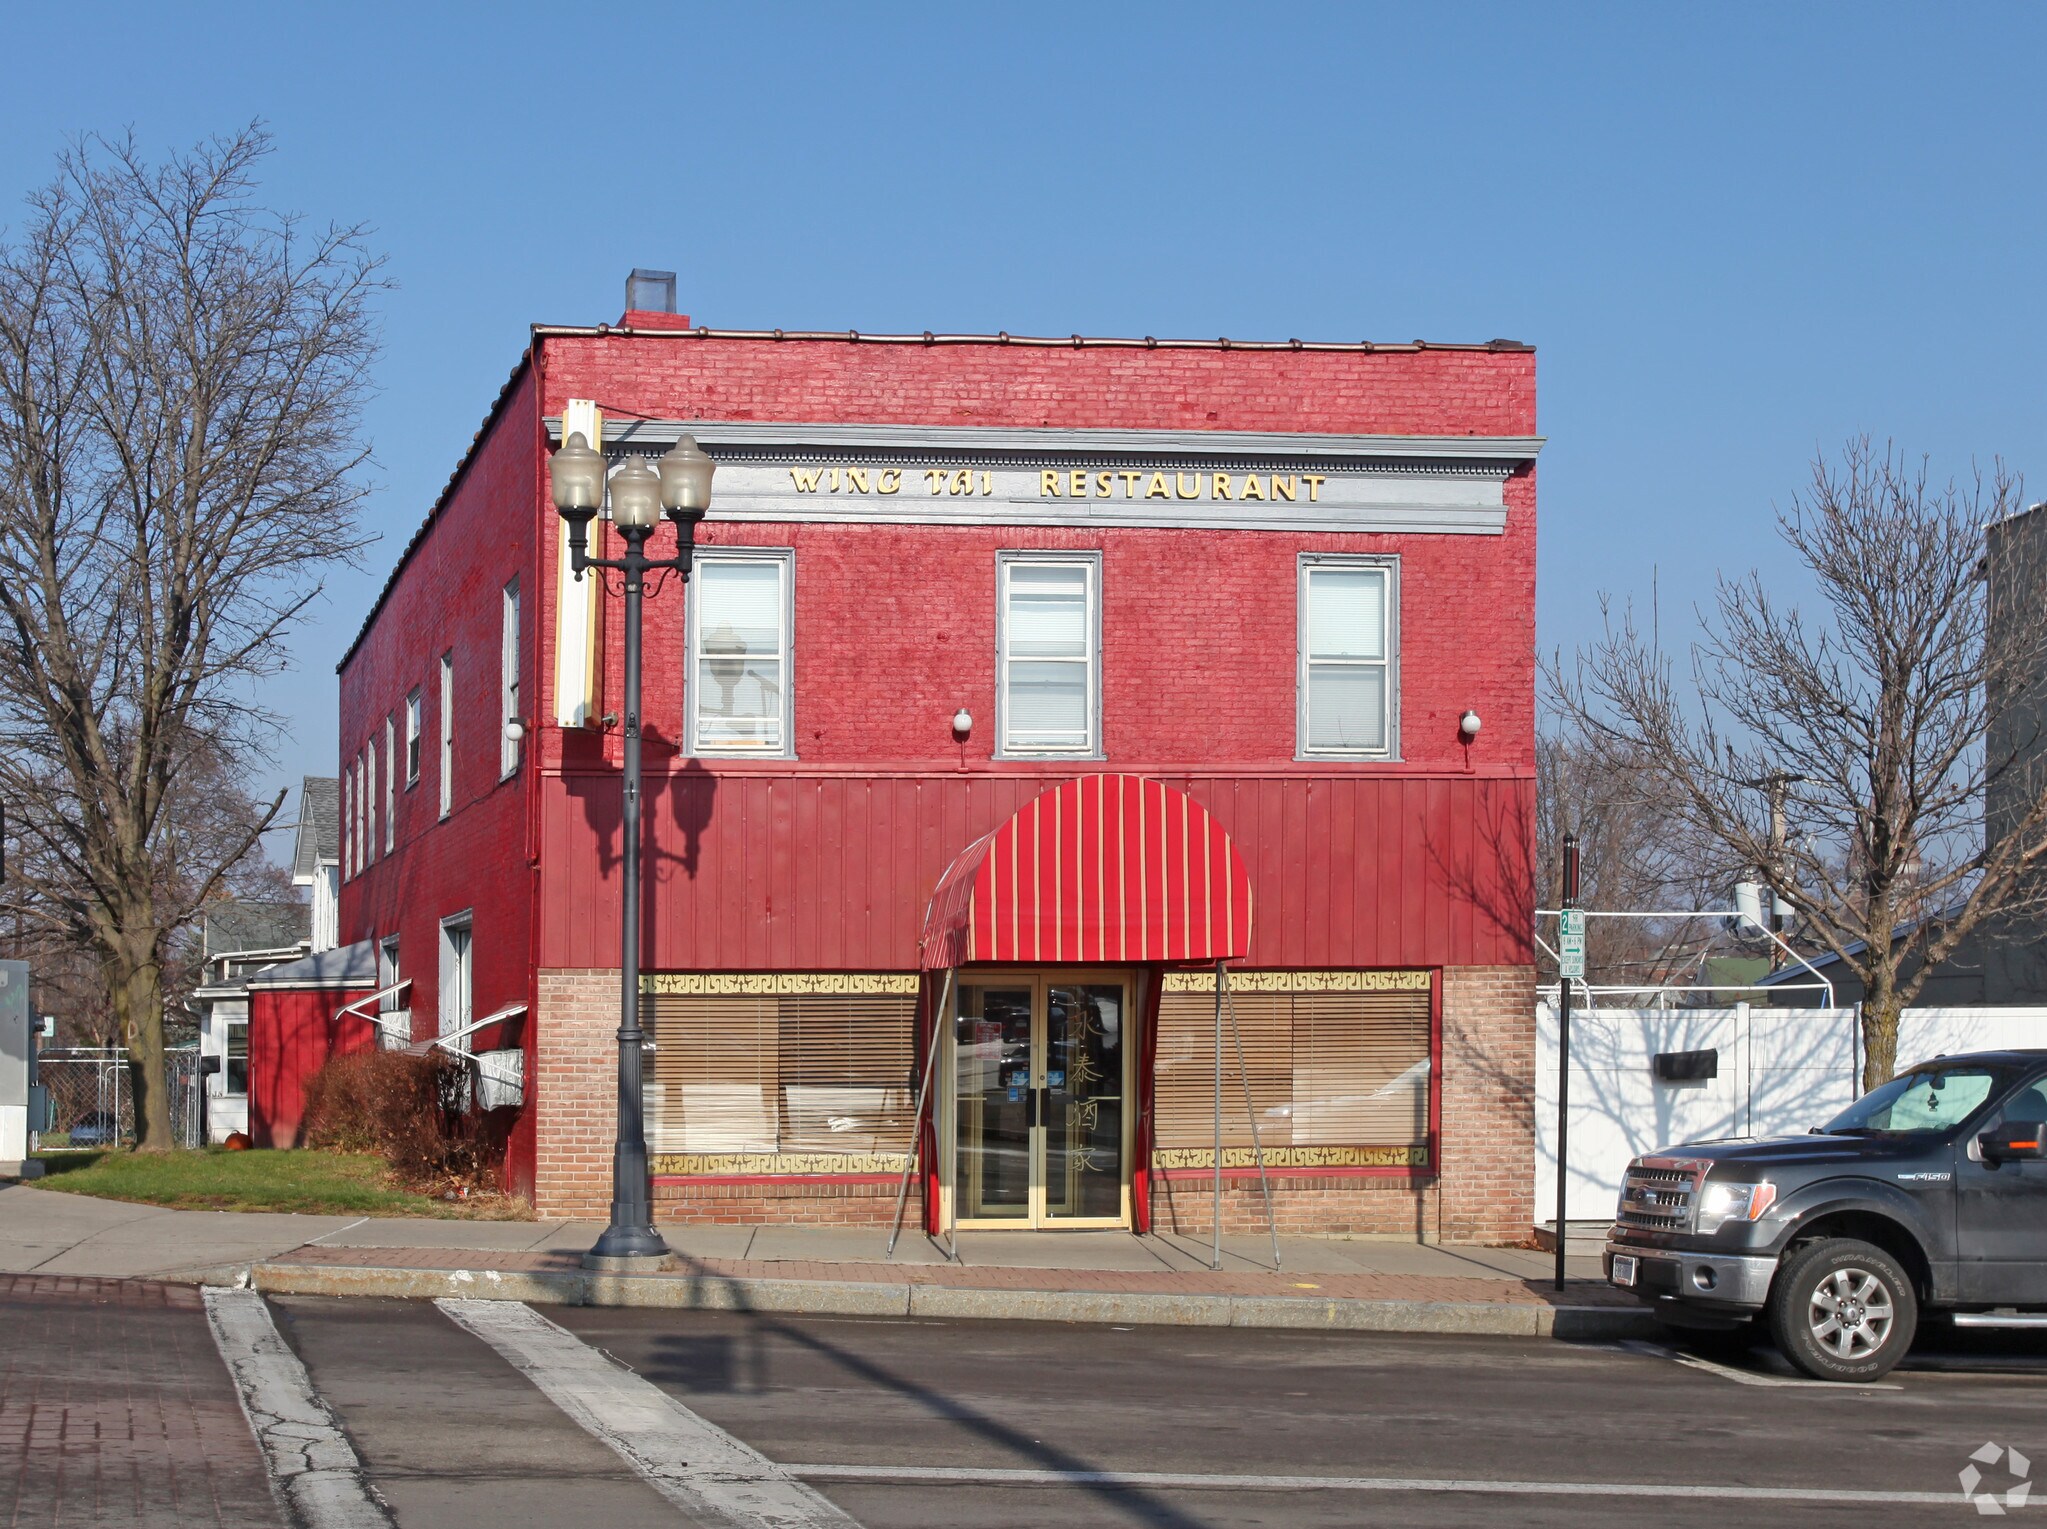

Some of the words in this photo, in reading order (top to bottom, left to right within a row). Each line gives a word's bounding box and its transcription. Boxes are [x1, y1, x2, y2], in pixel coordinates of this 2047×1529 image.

[790, 466, 901, 493] WING
[924, 469, 992, 495] TAI
[1040, 470, 1326, 501] RESTAURANT
[1562, 914, 1568, 931] 2
[1831, 1254, 1906, 1297] WRANGLER
